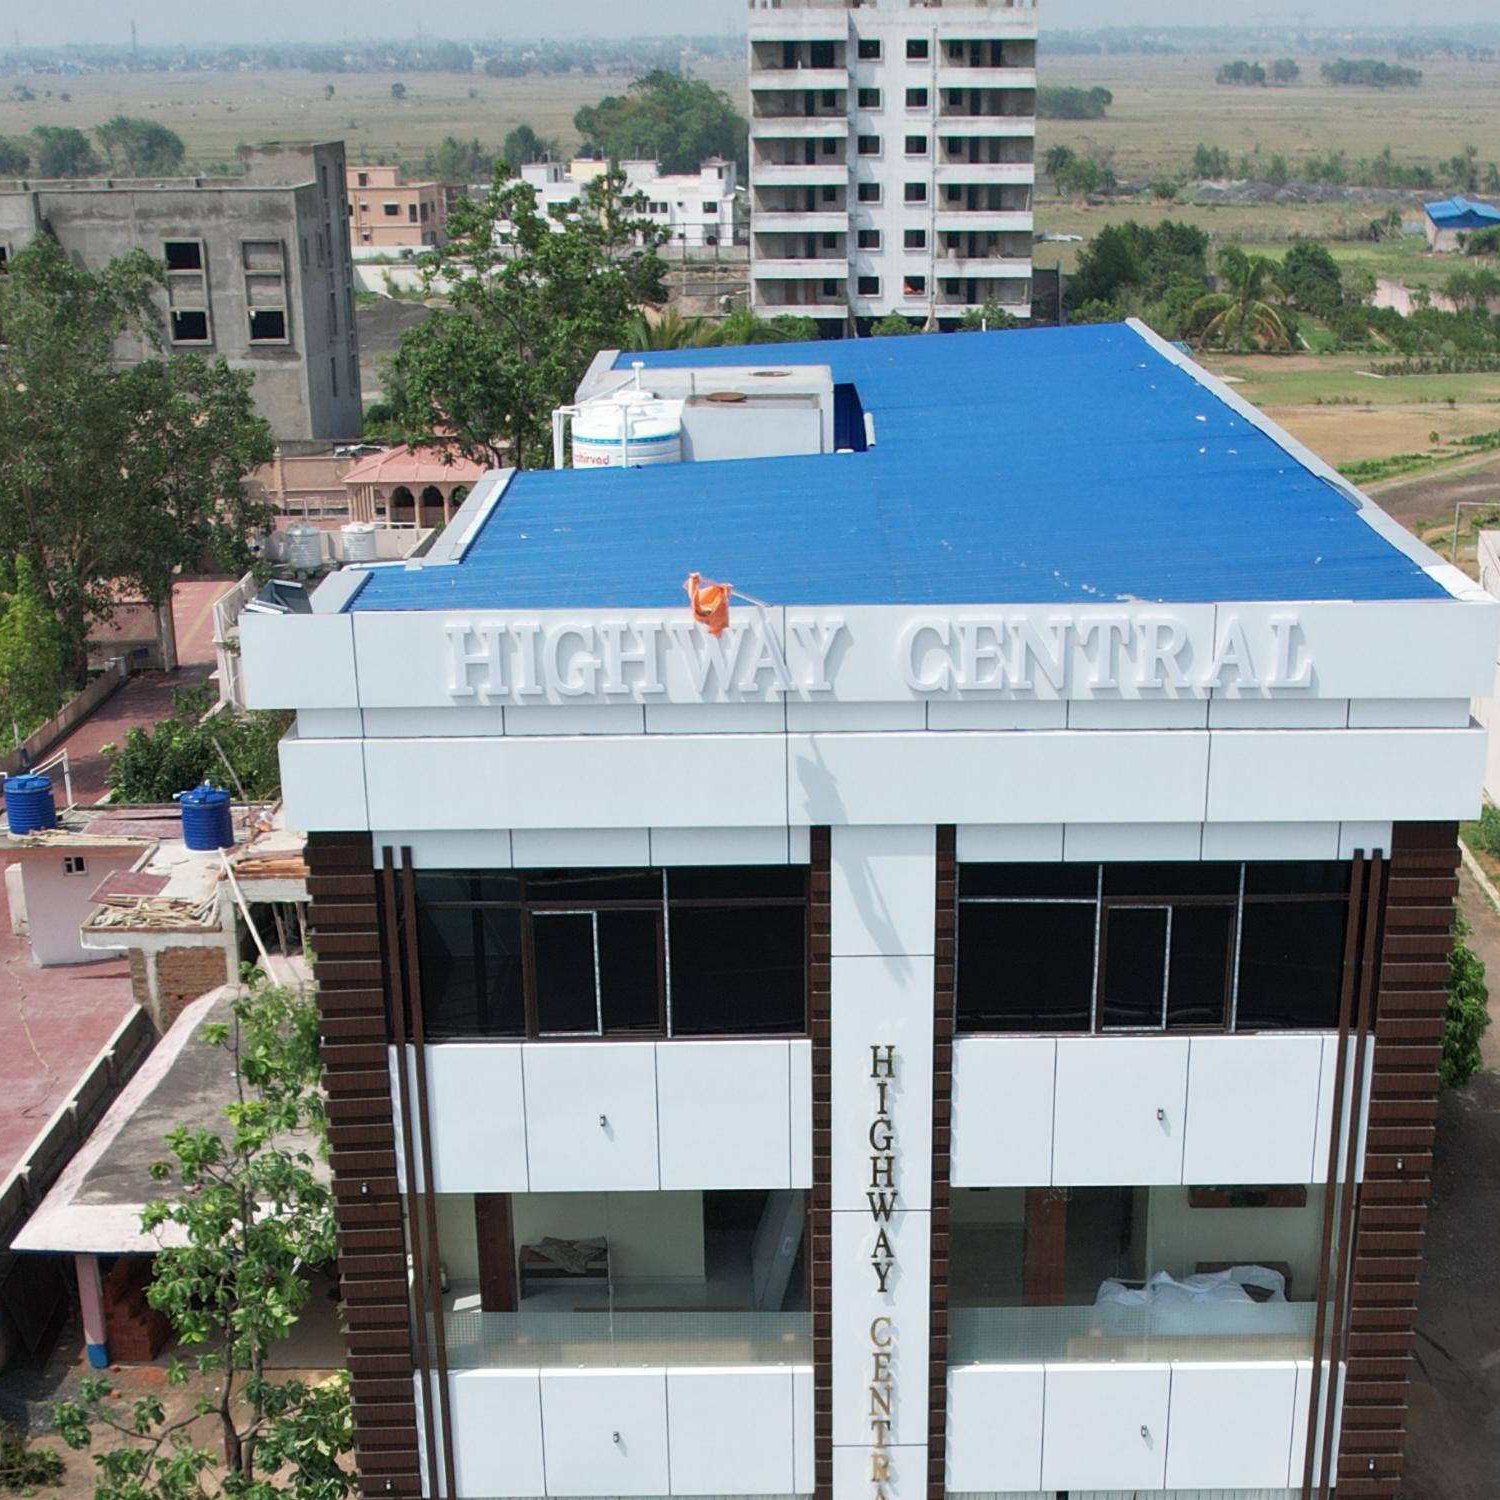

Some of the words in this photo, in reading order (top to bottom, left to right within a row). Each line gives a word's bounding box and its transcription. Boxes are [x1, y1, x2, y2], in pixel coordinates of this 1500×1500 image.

[443, 616, 847, 697] HIGHWAY
[899, 613, 1314, 692] CENTRAL
[866, 1045, 899, 1293] HIGHWAY
